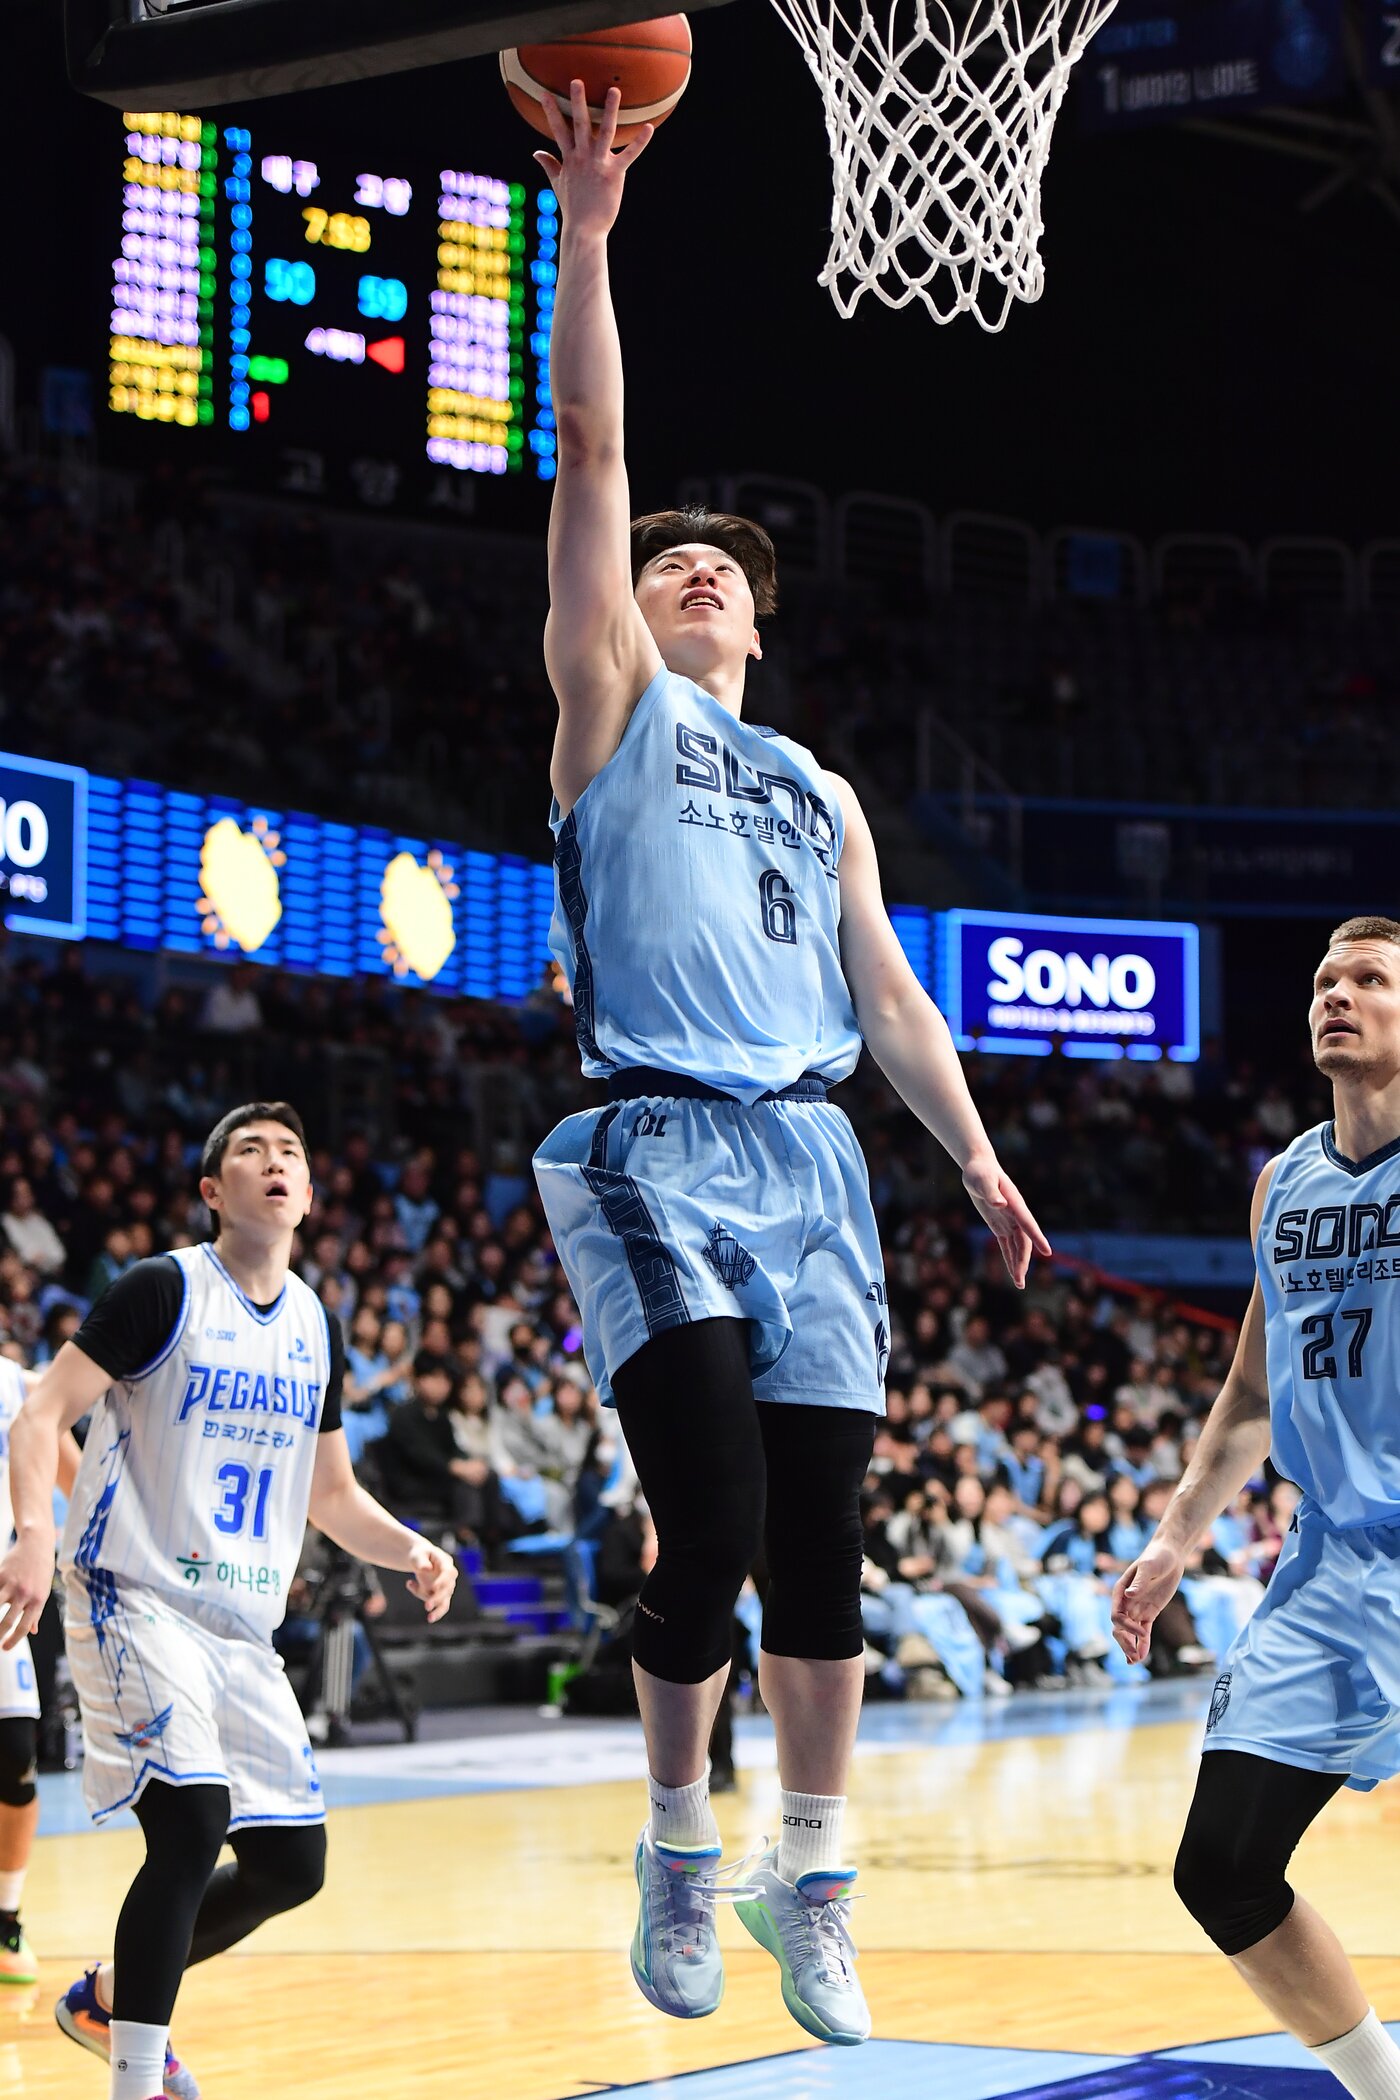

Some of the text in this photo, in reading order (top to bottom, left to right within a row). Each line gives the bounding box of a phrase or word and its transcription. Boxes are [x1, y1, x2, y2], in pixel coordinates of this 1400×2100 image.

[758, 867, 798, 945] 6
[986, 936, 1156, 1010] SONO
[1301, 1307, 1374, 1380] 27
[177, 1363, 321, 1430] PEGASUS
[212, 1461, 274, 1540] 31
